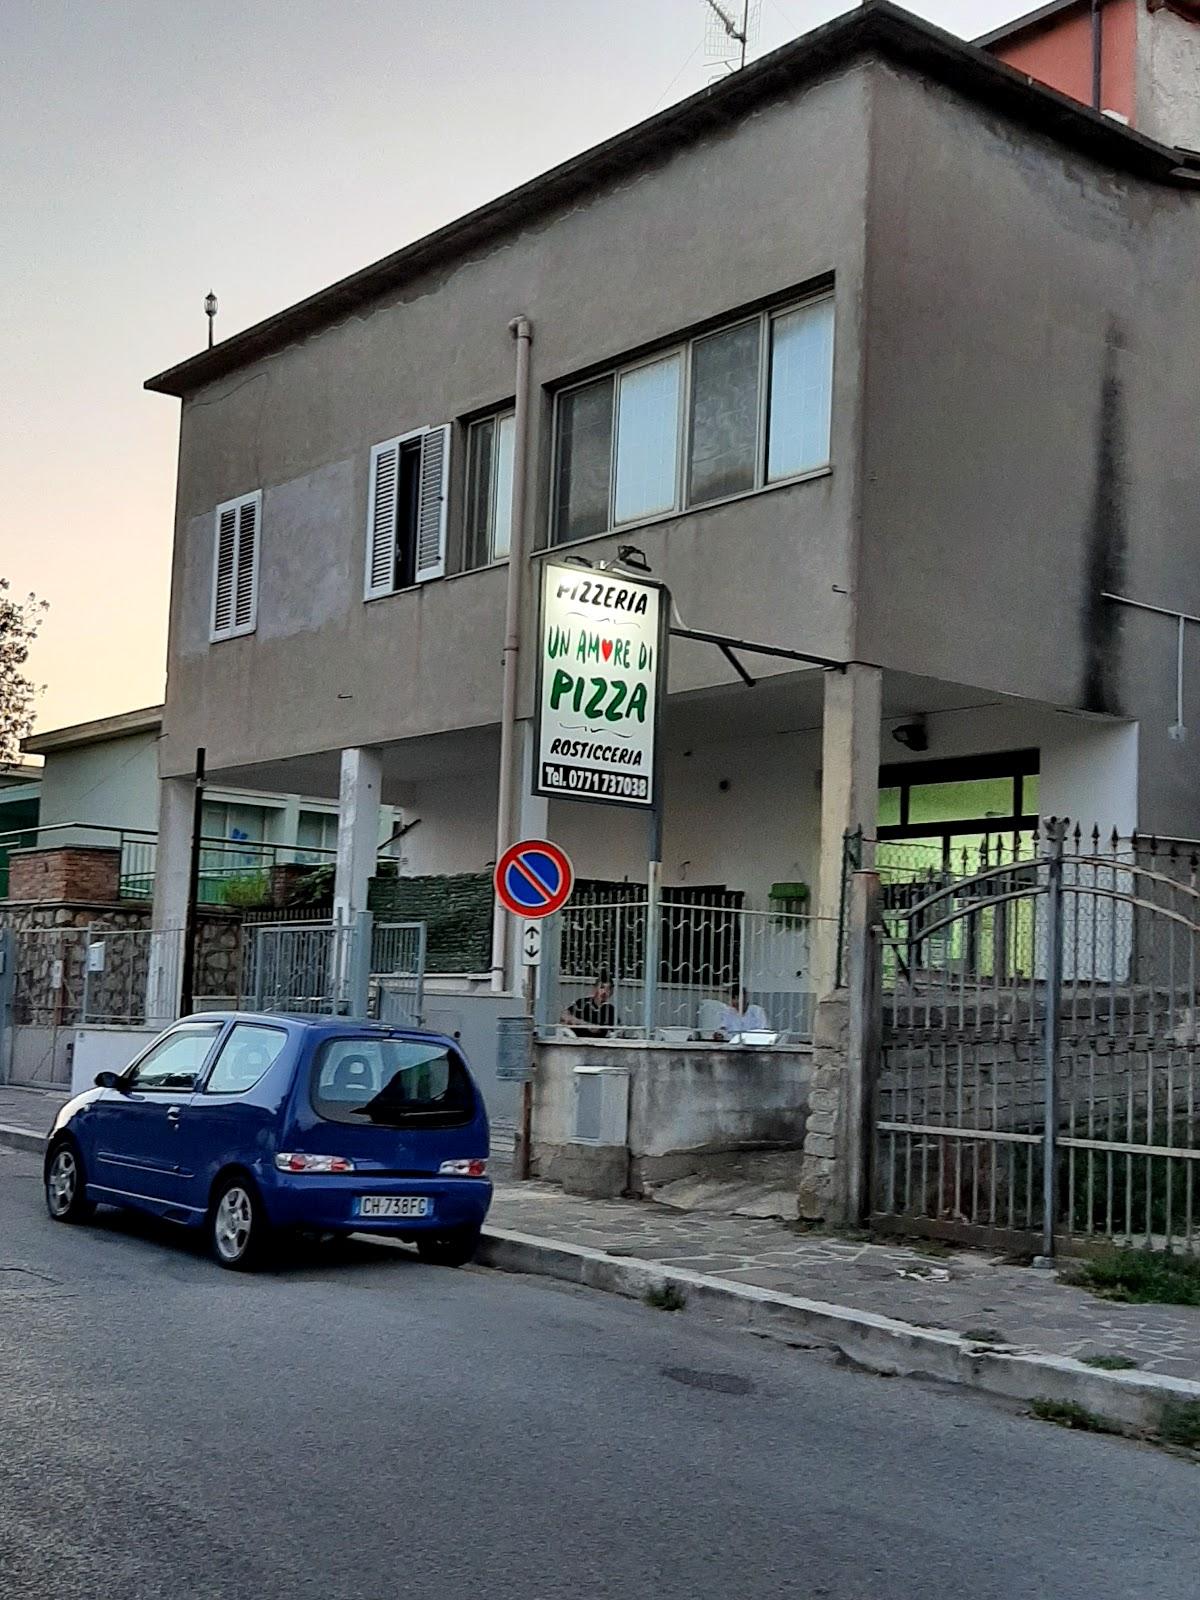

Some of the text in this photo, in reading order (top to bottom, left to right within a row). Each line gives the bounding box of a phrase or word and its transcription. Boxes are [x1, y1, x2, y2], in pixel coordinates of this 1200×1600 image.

[557, 581, 648, 615] PIZZERIA
[548, 624, 571, 659] UN
[638, 641, 652, 672] DI
[550, 668, 648, 723] PIZZA
[550, 738, 643, 766] ROSTICCERIA
[545, 766, 648, 797] Tel. 0771 737038
